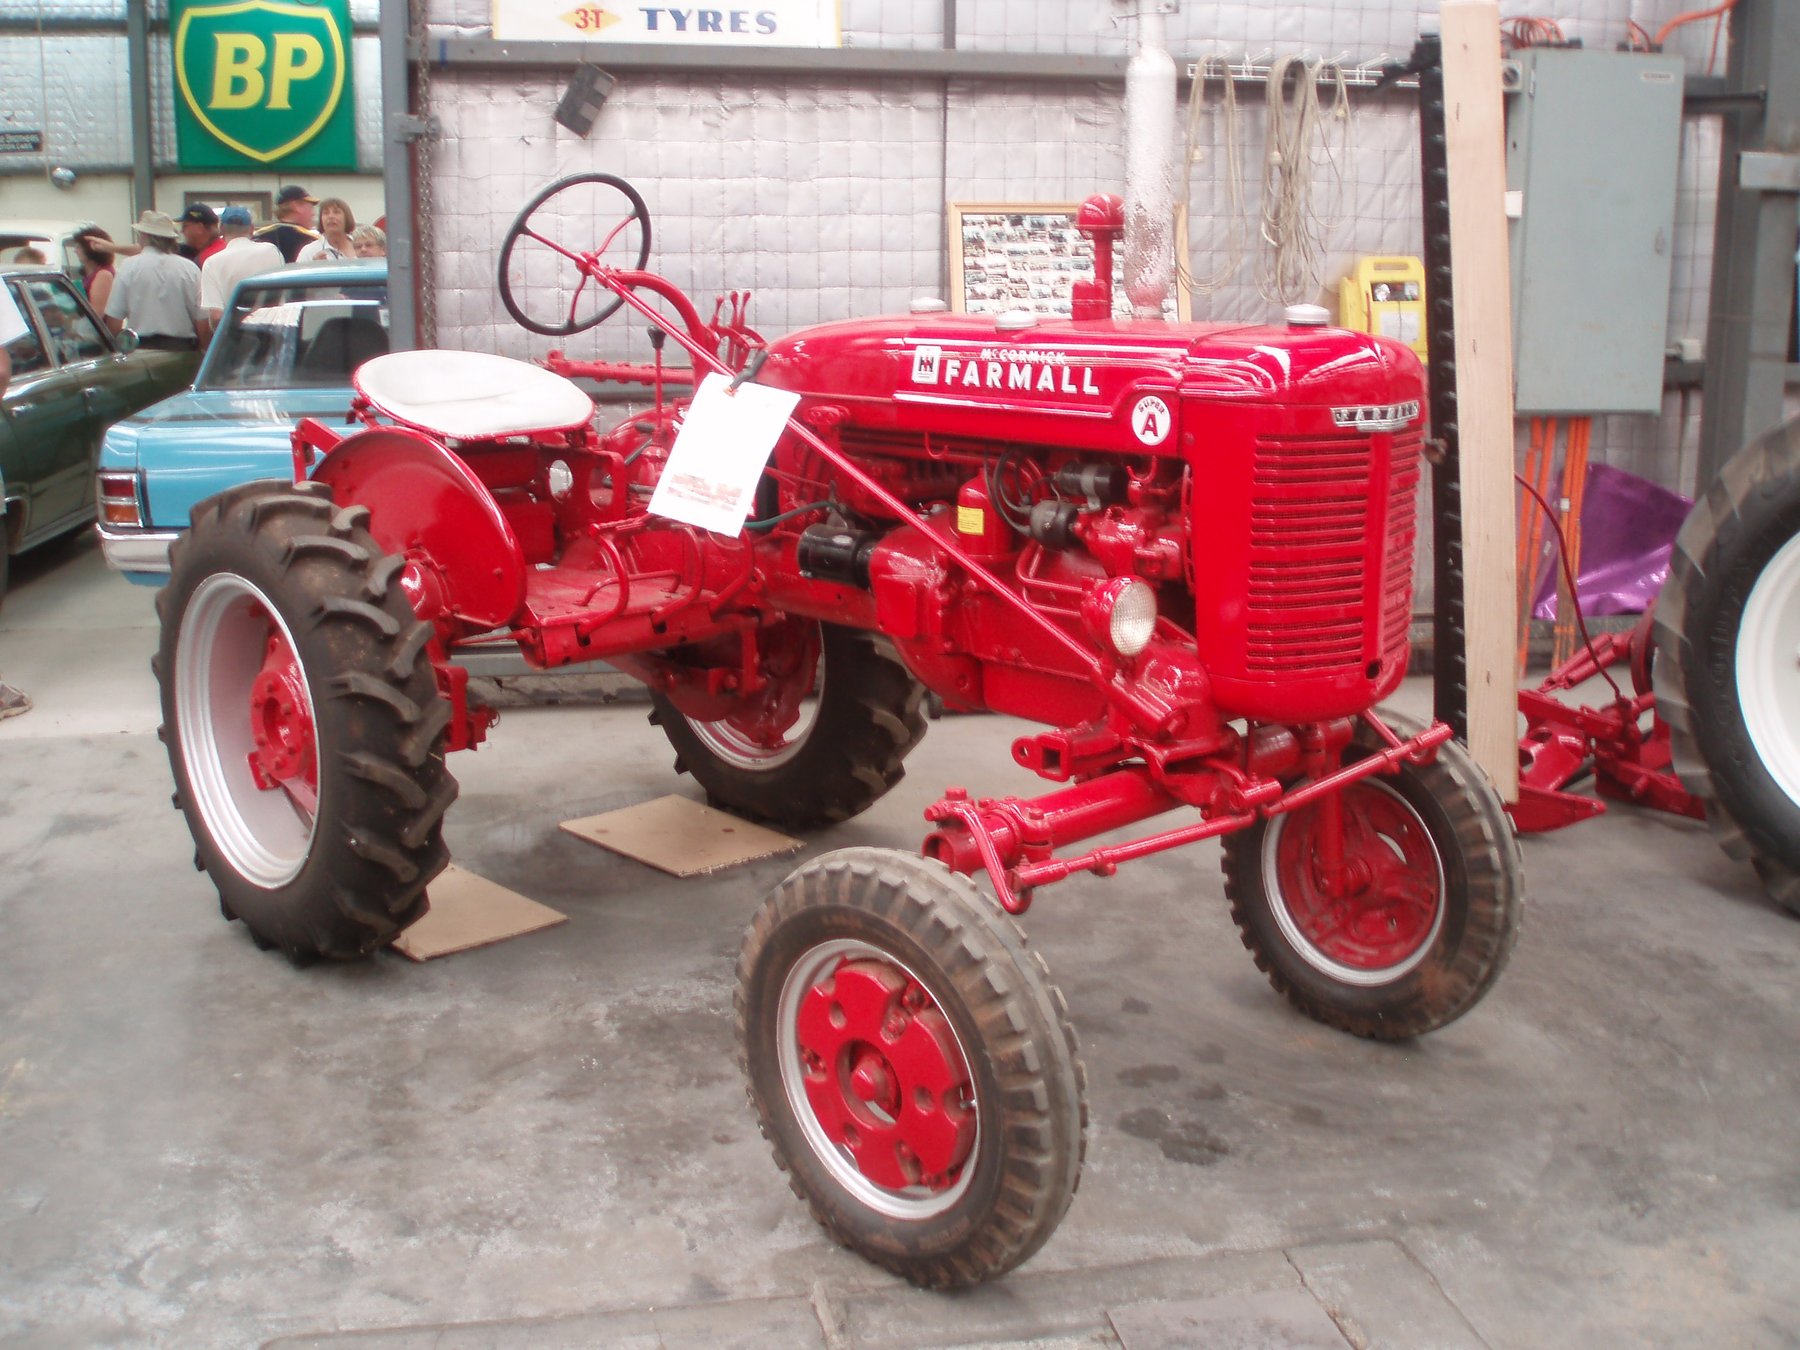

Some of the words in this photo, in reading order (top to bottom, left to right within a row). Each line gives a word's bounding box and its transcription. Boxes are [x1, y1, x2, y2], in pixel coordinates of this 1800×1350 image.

[639, 7, 778, 34] TYRES
[206, 32, 325, 109] BP
[944, 359, 1100, 396] FARMALL
[1140, 412, 1159, 437] A
